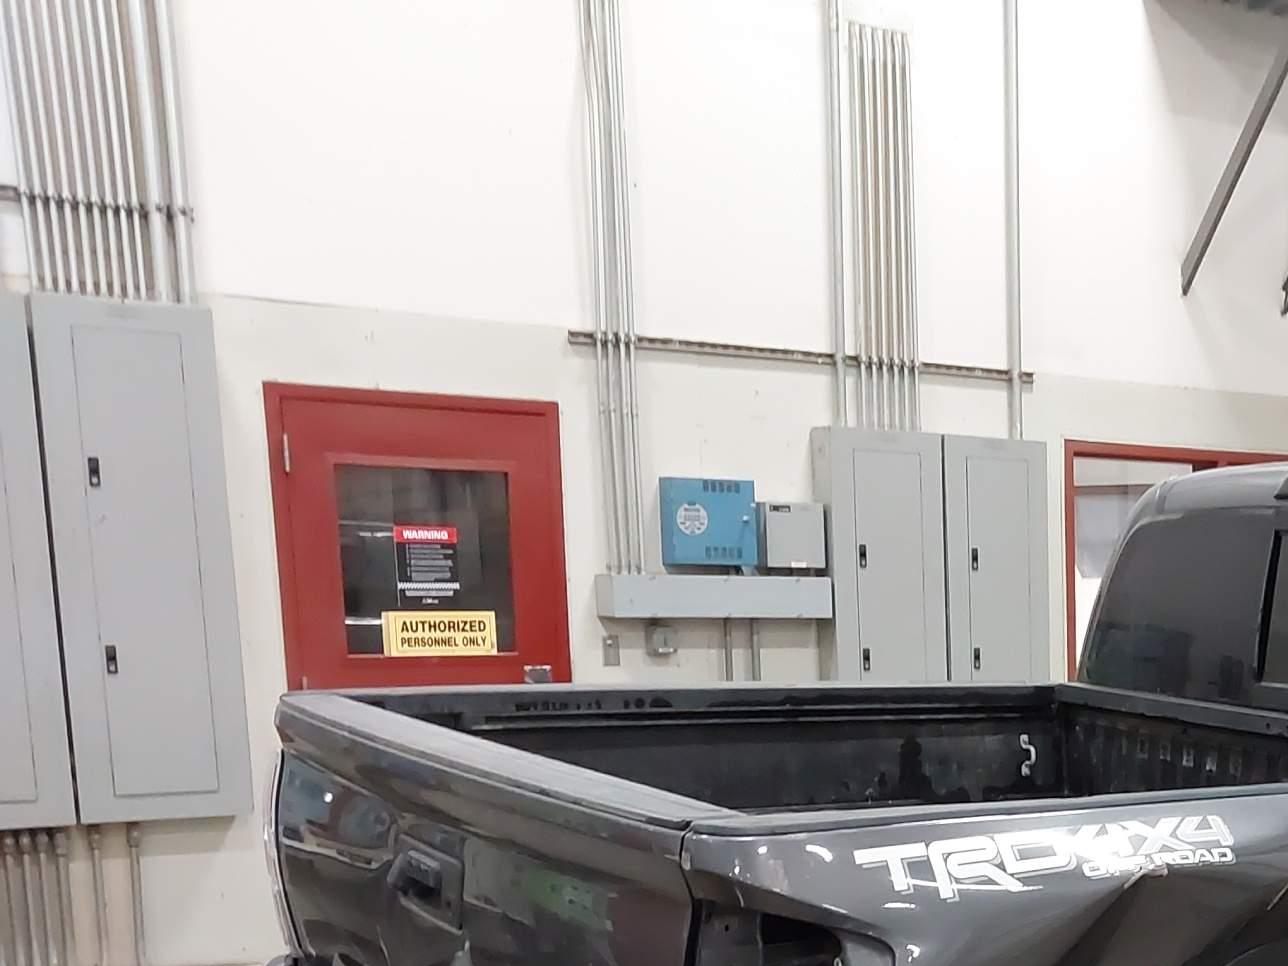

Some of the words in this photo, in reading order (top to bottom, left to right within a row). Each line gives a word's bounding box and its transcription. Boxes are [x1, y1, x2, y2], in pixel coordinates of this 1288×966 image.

[402, 529, 449, 540] WARNING
[400, 620, 487, 633] AUTHORIZED
[400, 636, 459, 648] PERSONNEL
[462, 636, 487, 647] ONLY
[853, 828, 1078, 902] TRD
